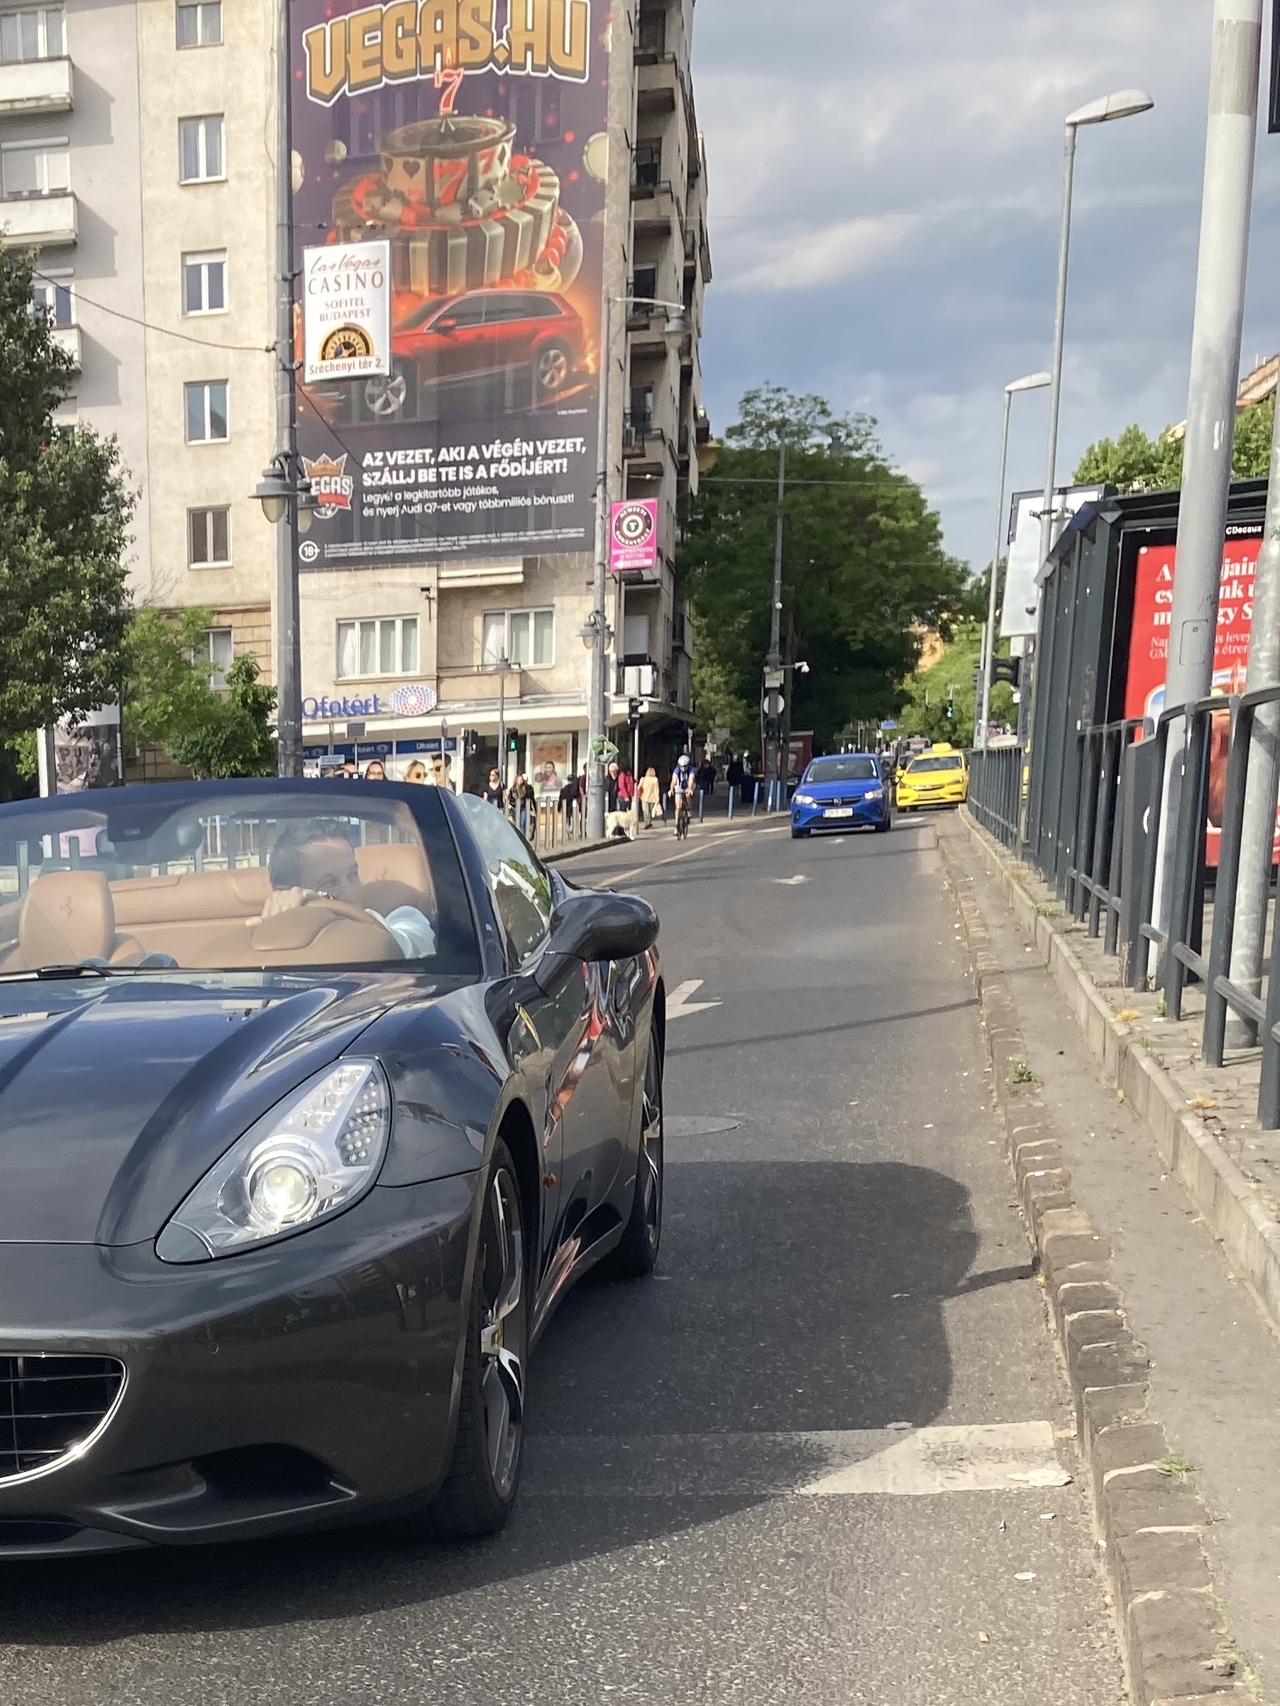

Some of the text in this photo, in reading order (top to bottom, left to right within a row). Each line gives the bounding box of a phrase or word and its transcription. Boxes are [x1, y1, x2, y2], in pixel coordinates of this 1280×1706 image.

[304, 0, 588, 105] VEGAS.HU
[311, 254, 381, 275] Las Vegas
[308, 271, 384, 295] CASINO
[324, 297, 366, 309] SOFITEL
[319, 308, 372, 322] BUDAPEST
[309, 358, 384, 375] Széchenyi tér 2.
[361, 437, 587, 468] AZ VEZET, AKI A VÉGÉN VEZET,
[362, 456, 568, 487] SZÁLLJ BE TE IS A FŐDÍJÉRT!
[310, 474, 351, 496] EGAS
[394, 492, 402, 501] a
[403, 486, 461, 503] legkitartóbb
[462, 485, 499, 500] játékos,
[362, 493, 575, 518] és nyerj Audi Q7-et vagy többmilliós bónuszt!
[1225, 525, 1262, 535] CDecaux
[302, 693, 382, 719] Ofotért
